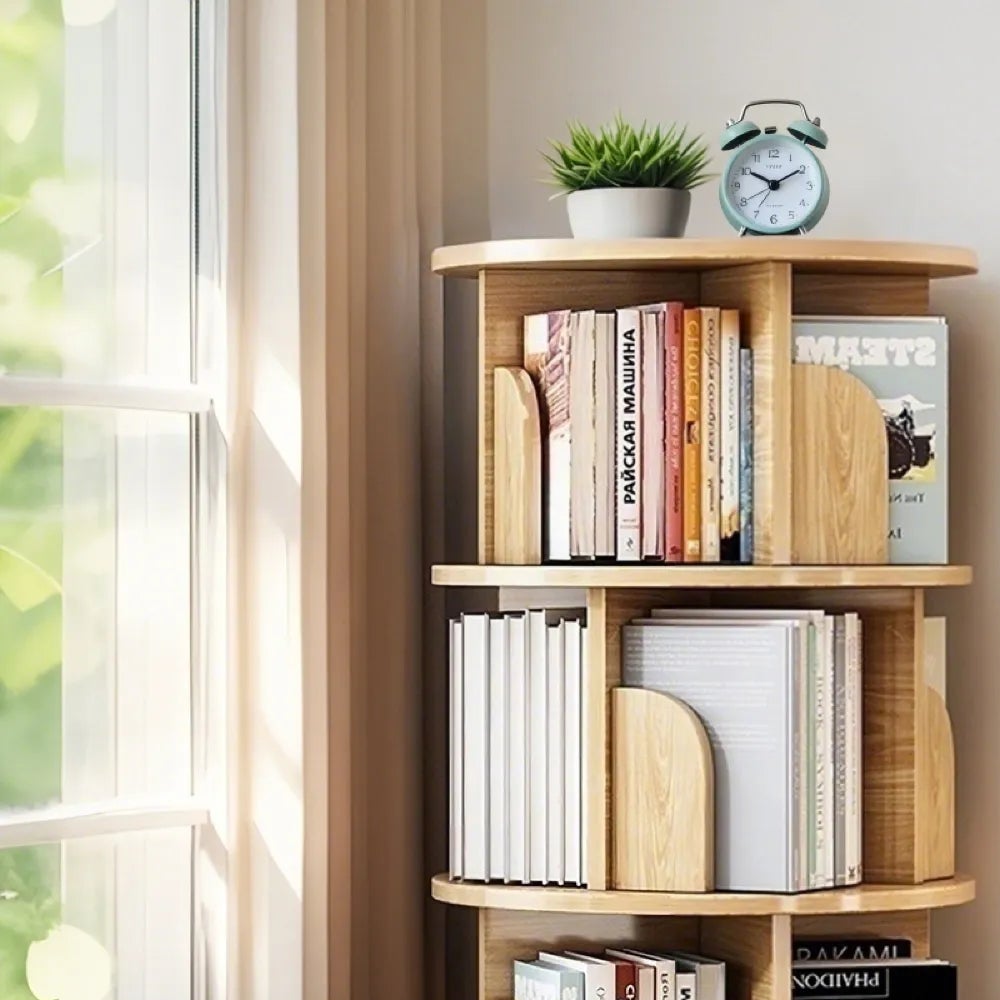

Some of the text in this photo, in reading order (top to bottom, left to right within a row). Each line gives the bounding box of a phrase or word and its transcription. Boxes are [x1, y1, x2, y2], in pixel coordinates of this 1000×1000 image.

[751, 153, 761, 163] 11
[768, 148, 780, 159] 12
[741, 167, 751, 176] 10
[798, 164, 806, 174] 2
[733, 182, 741, 191] 9
[806, 181, 814, 191] 3
[740, 197, 748, 207] 8
[799, 198, 807, 207] 4
[753, 210, 760, 219] 7
[769, 214, 778, 225] 6
[788, 210, 795, 220] 5
[623, 328, 636, 413] МАШИНА
[622, 420, 636, 505] РАЙСКАЯ
[791, 971, 880, 989] PHAIDON
